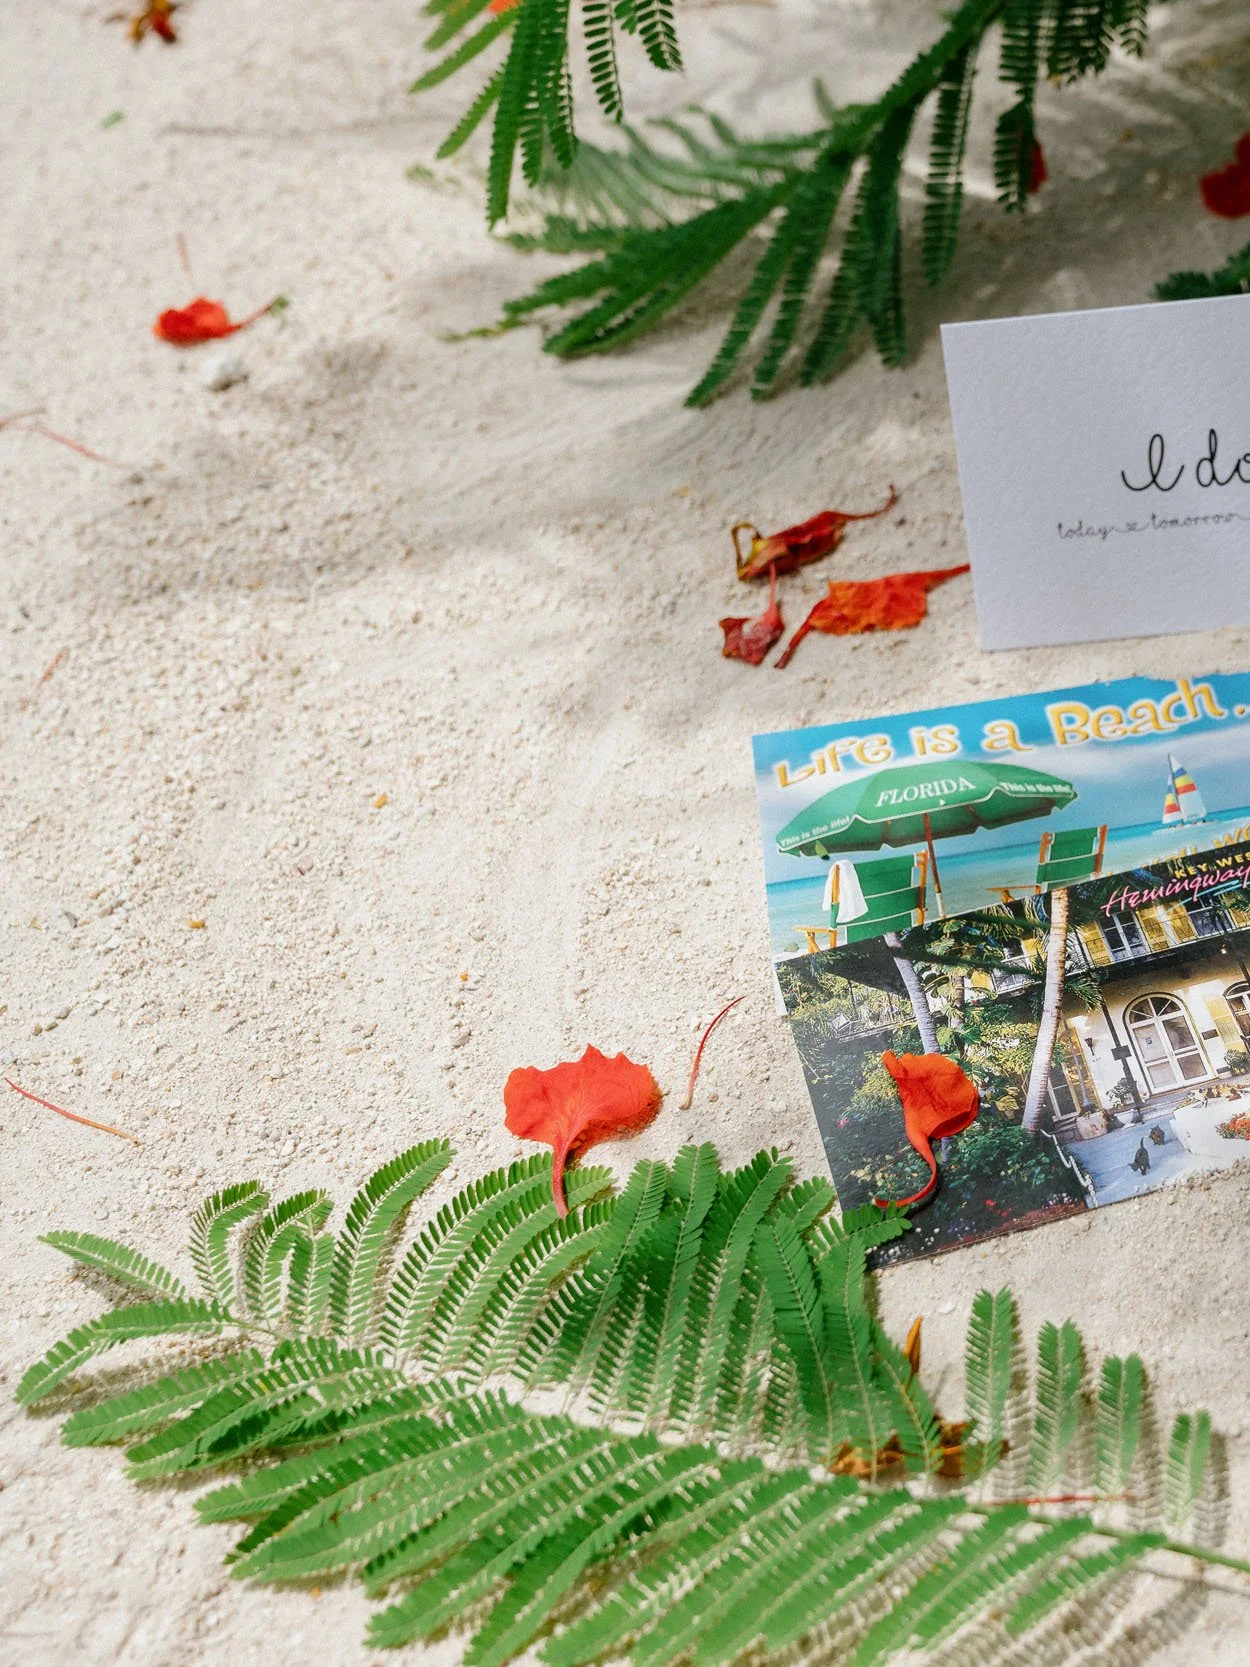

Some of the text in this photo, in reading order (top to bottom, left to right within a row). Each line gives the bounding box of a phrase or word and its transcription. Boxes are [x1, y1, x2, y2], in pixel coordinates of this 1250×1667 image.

[1121, 433, 1185, 492] I
[1057, 519, 1113, 541] today
[1150, 512, 1240, 531] tomorrow
[775, 734, 893, 788] Life
[913, 725, 960, 756] is
[982, 721, 1034, 752] a
[875, 776, 976, 808] FLORIDA
[1174, 862, 1209, 879] KEY
